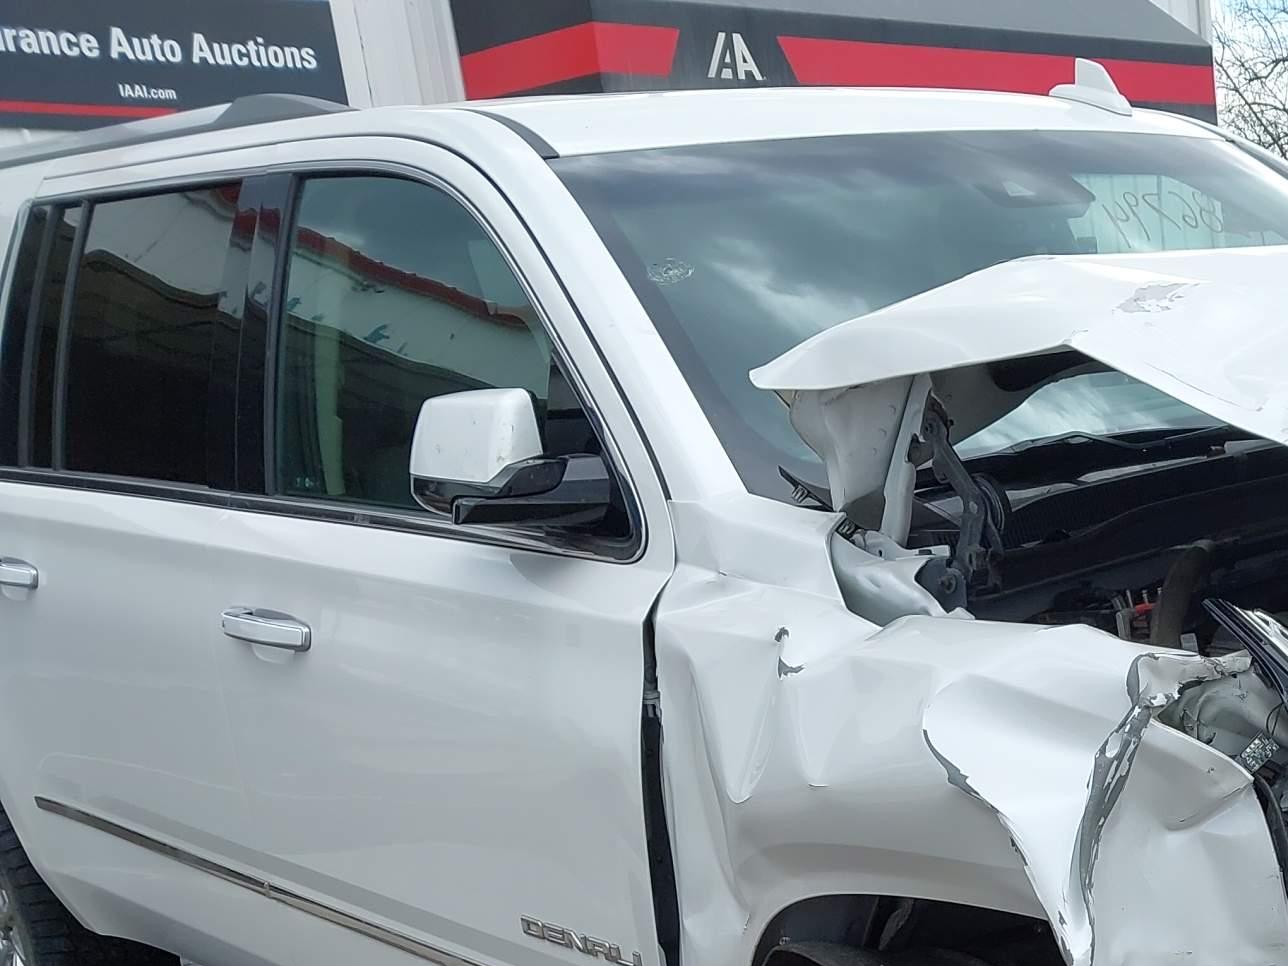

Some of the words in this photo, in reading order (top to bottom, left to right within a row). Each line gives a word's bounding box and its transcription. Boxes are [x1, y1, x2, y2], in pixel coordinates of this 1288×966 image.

[110, 26, 183, 63] Auto
[192, 32, 318, 70] Auctions
[118, 83, 178, 100] IAAI.com
